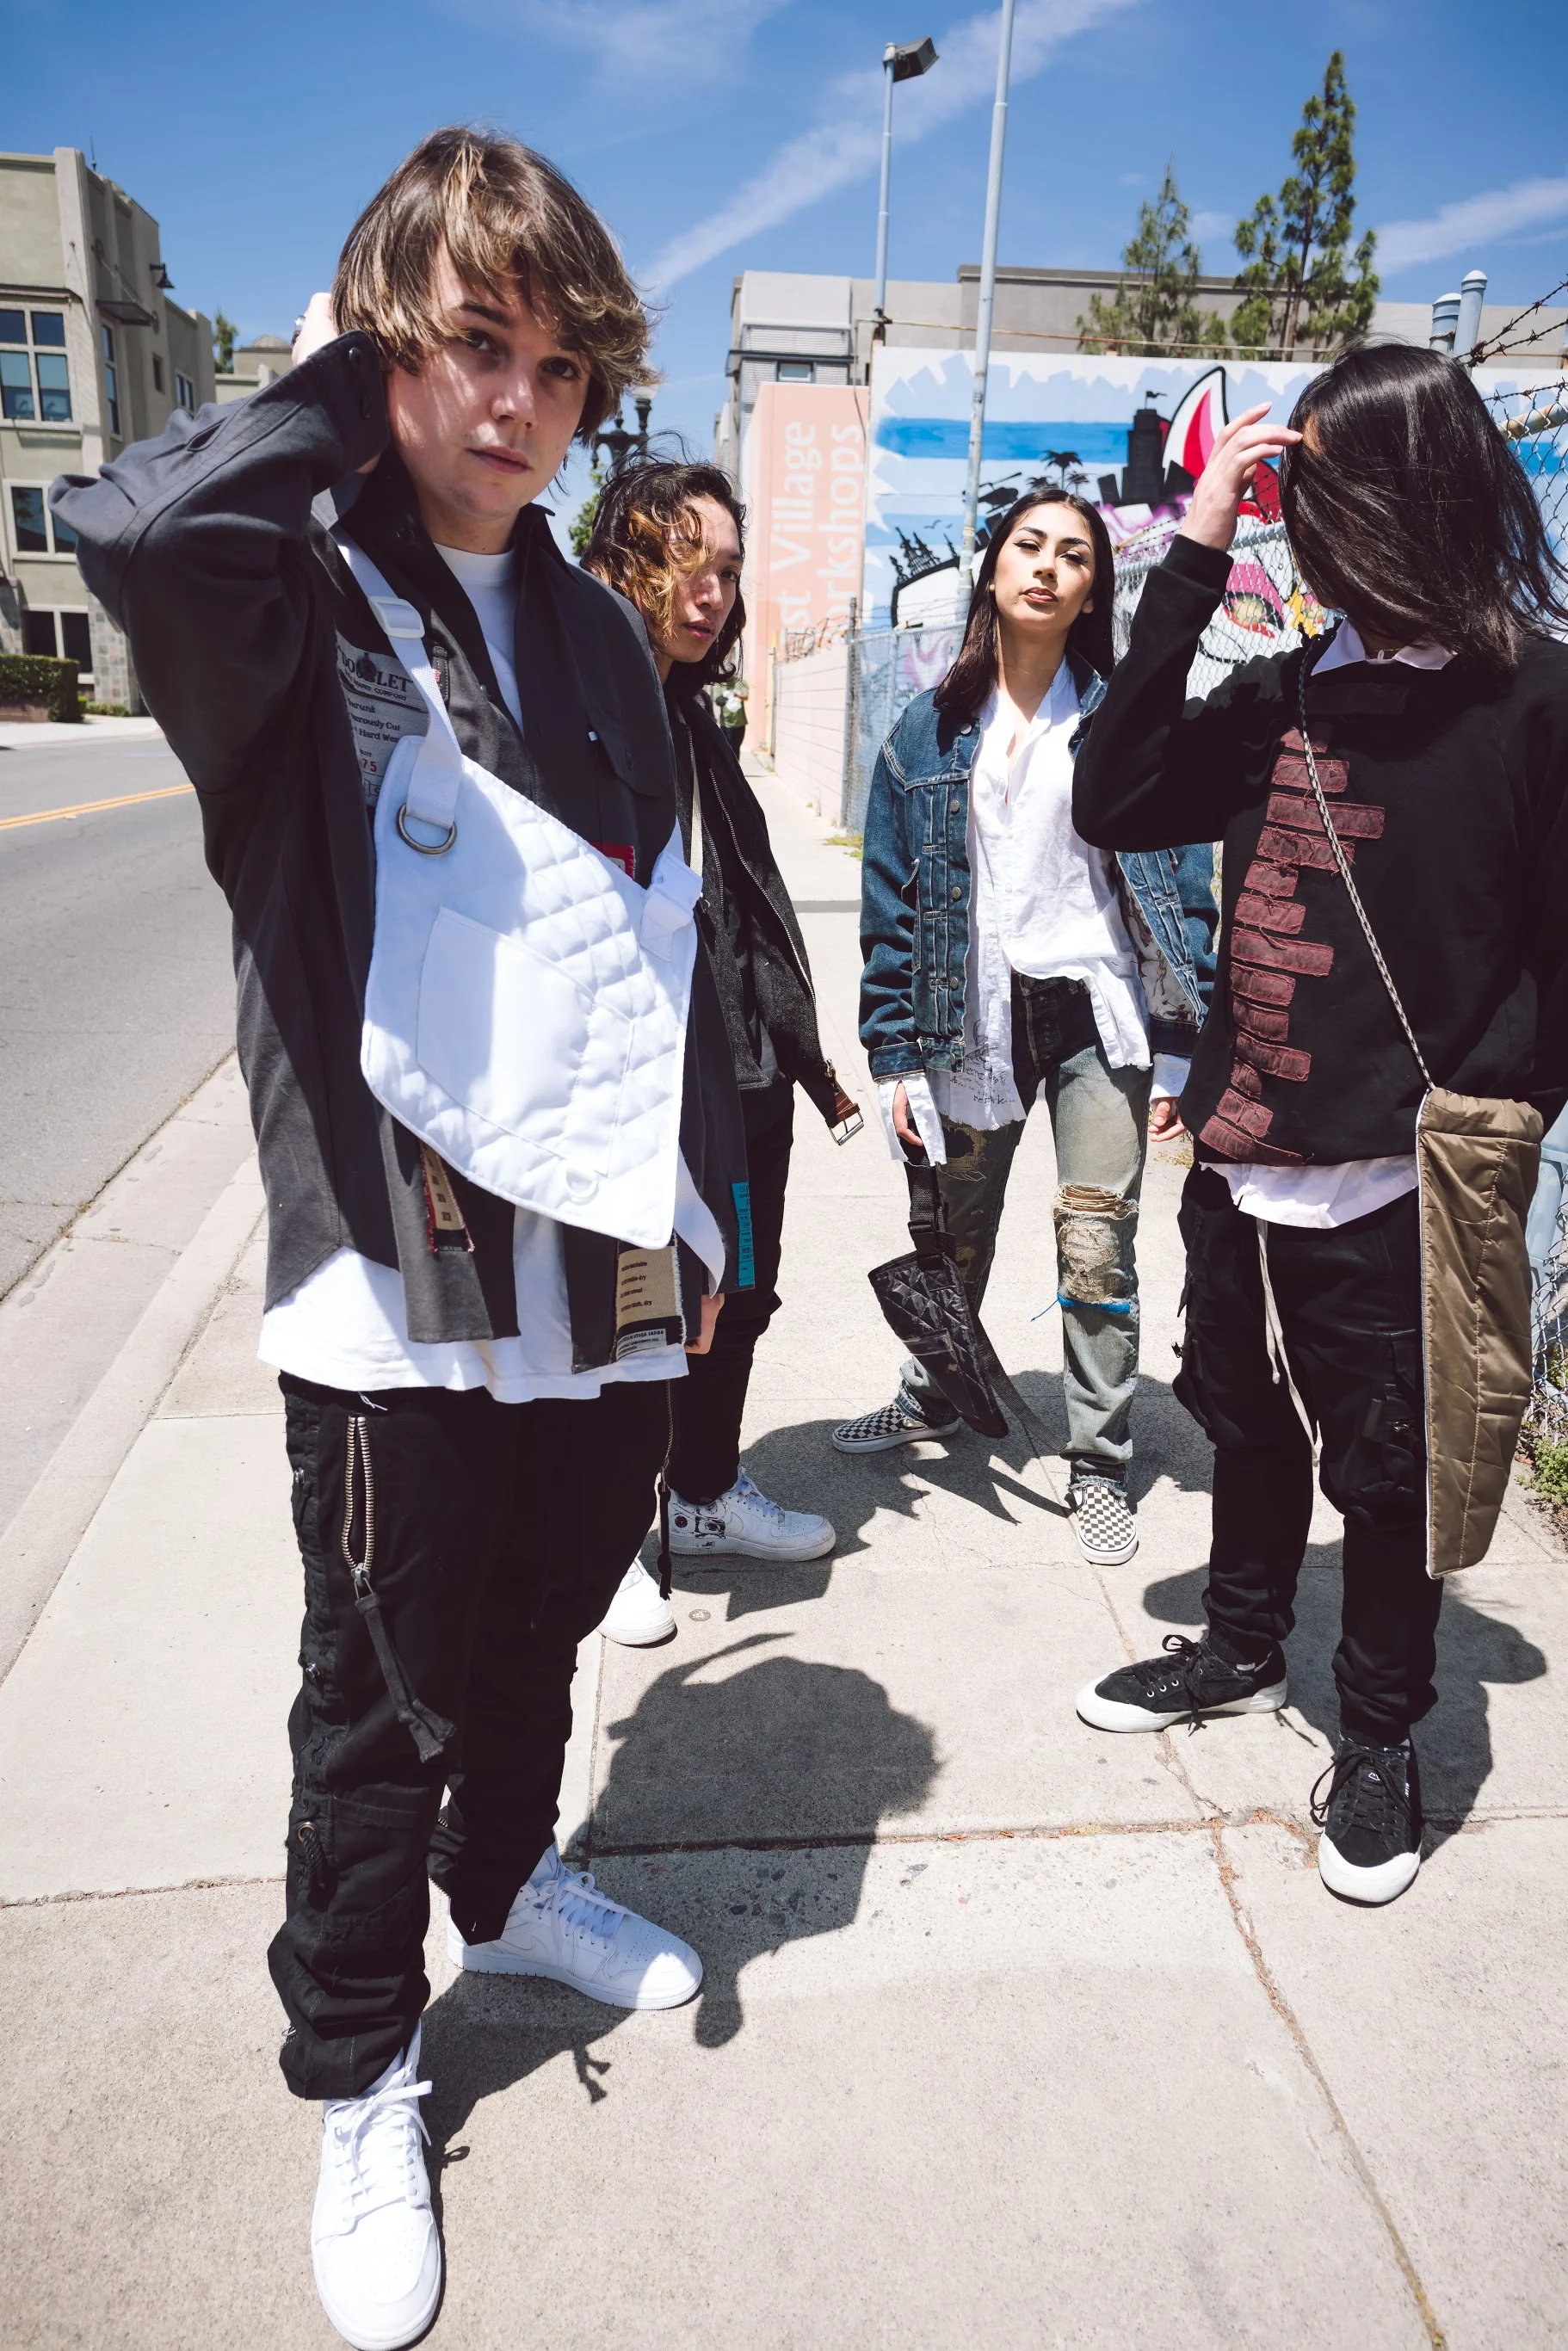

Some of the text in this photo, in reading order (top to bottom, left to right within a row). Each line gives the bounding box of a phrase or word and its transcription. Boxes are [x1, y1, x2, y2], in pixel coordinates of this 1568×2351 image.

[770, 421, 823, 571] Village
[816, 423, 865, 635] orkshops
[373, 688, 407, 701] COMFORT
[386, 721, 401, 731] Cut
[359, 728, 380, 741] Hard
